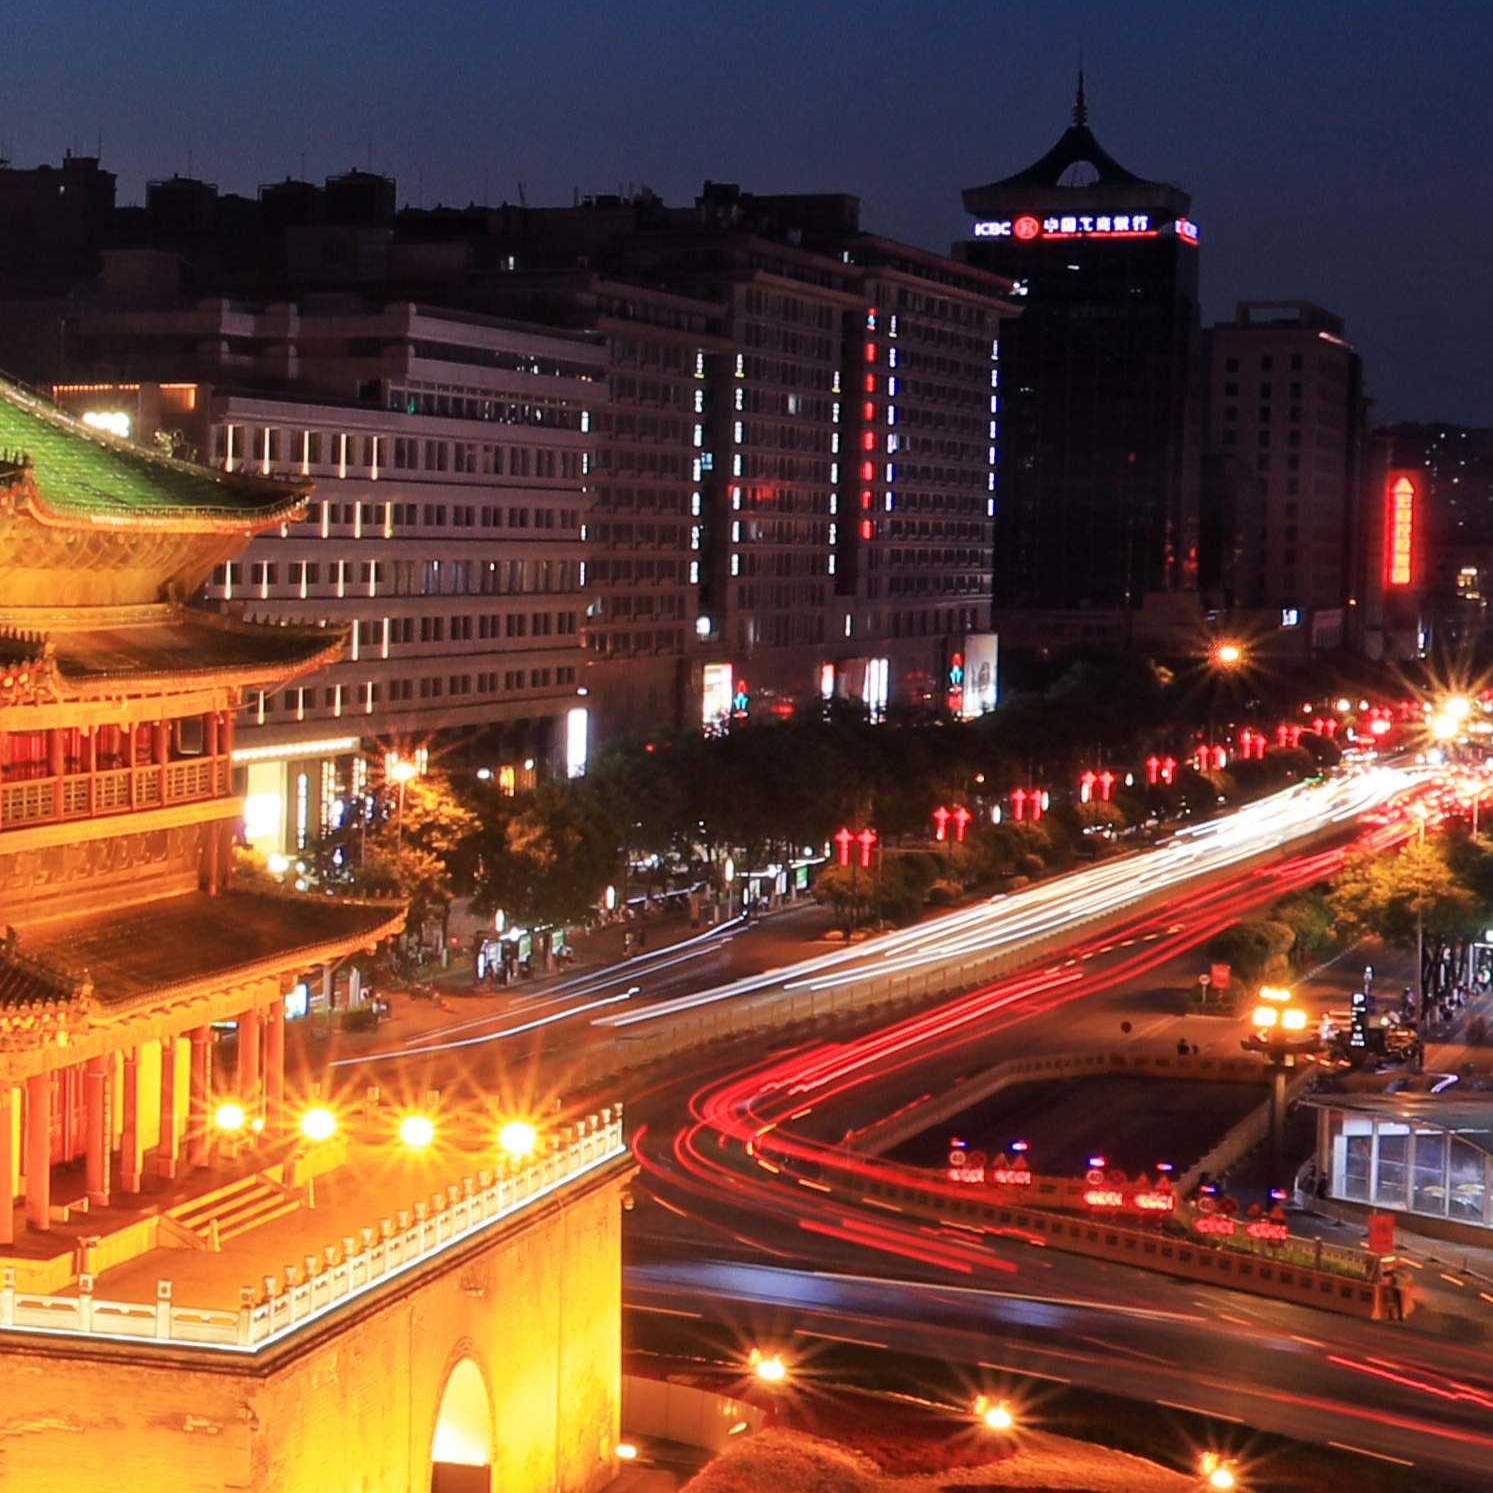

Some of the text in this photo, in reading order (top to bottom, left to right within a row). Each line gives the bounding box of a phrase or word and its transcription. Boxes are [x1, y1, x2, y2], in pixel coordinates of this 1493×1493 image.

[974, 221, 1011, 236] ICBC
[1043, 215, 1149, 233] 中国工商银行
